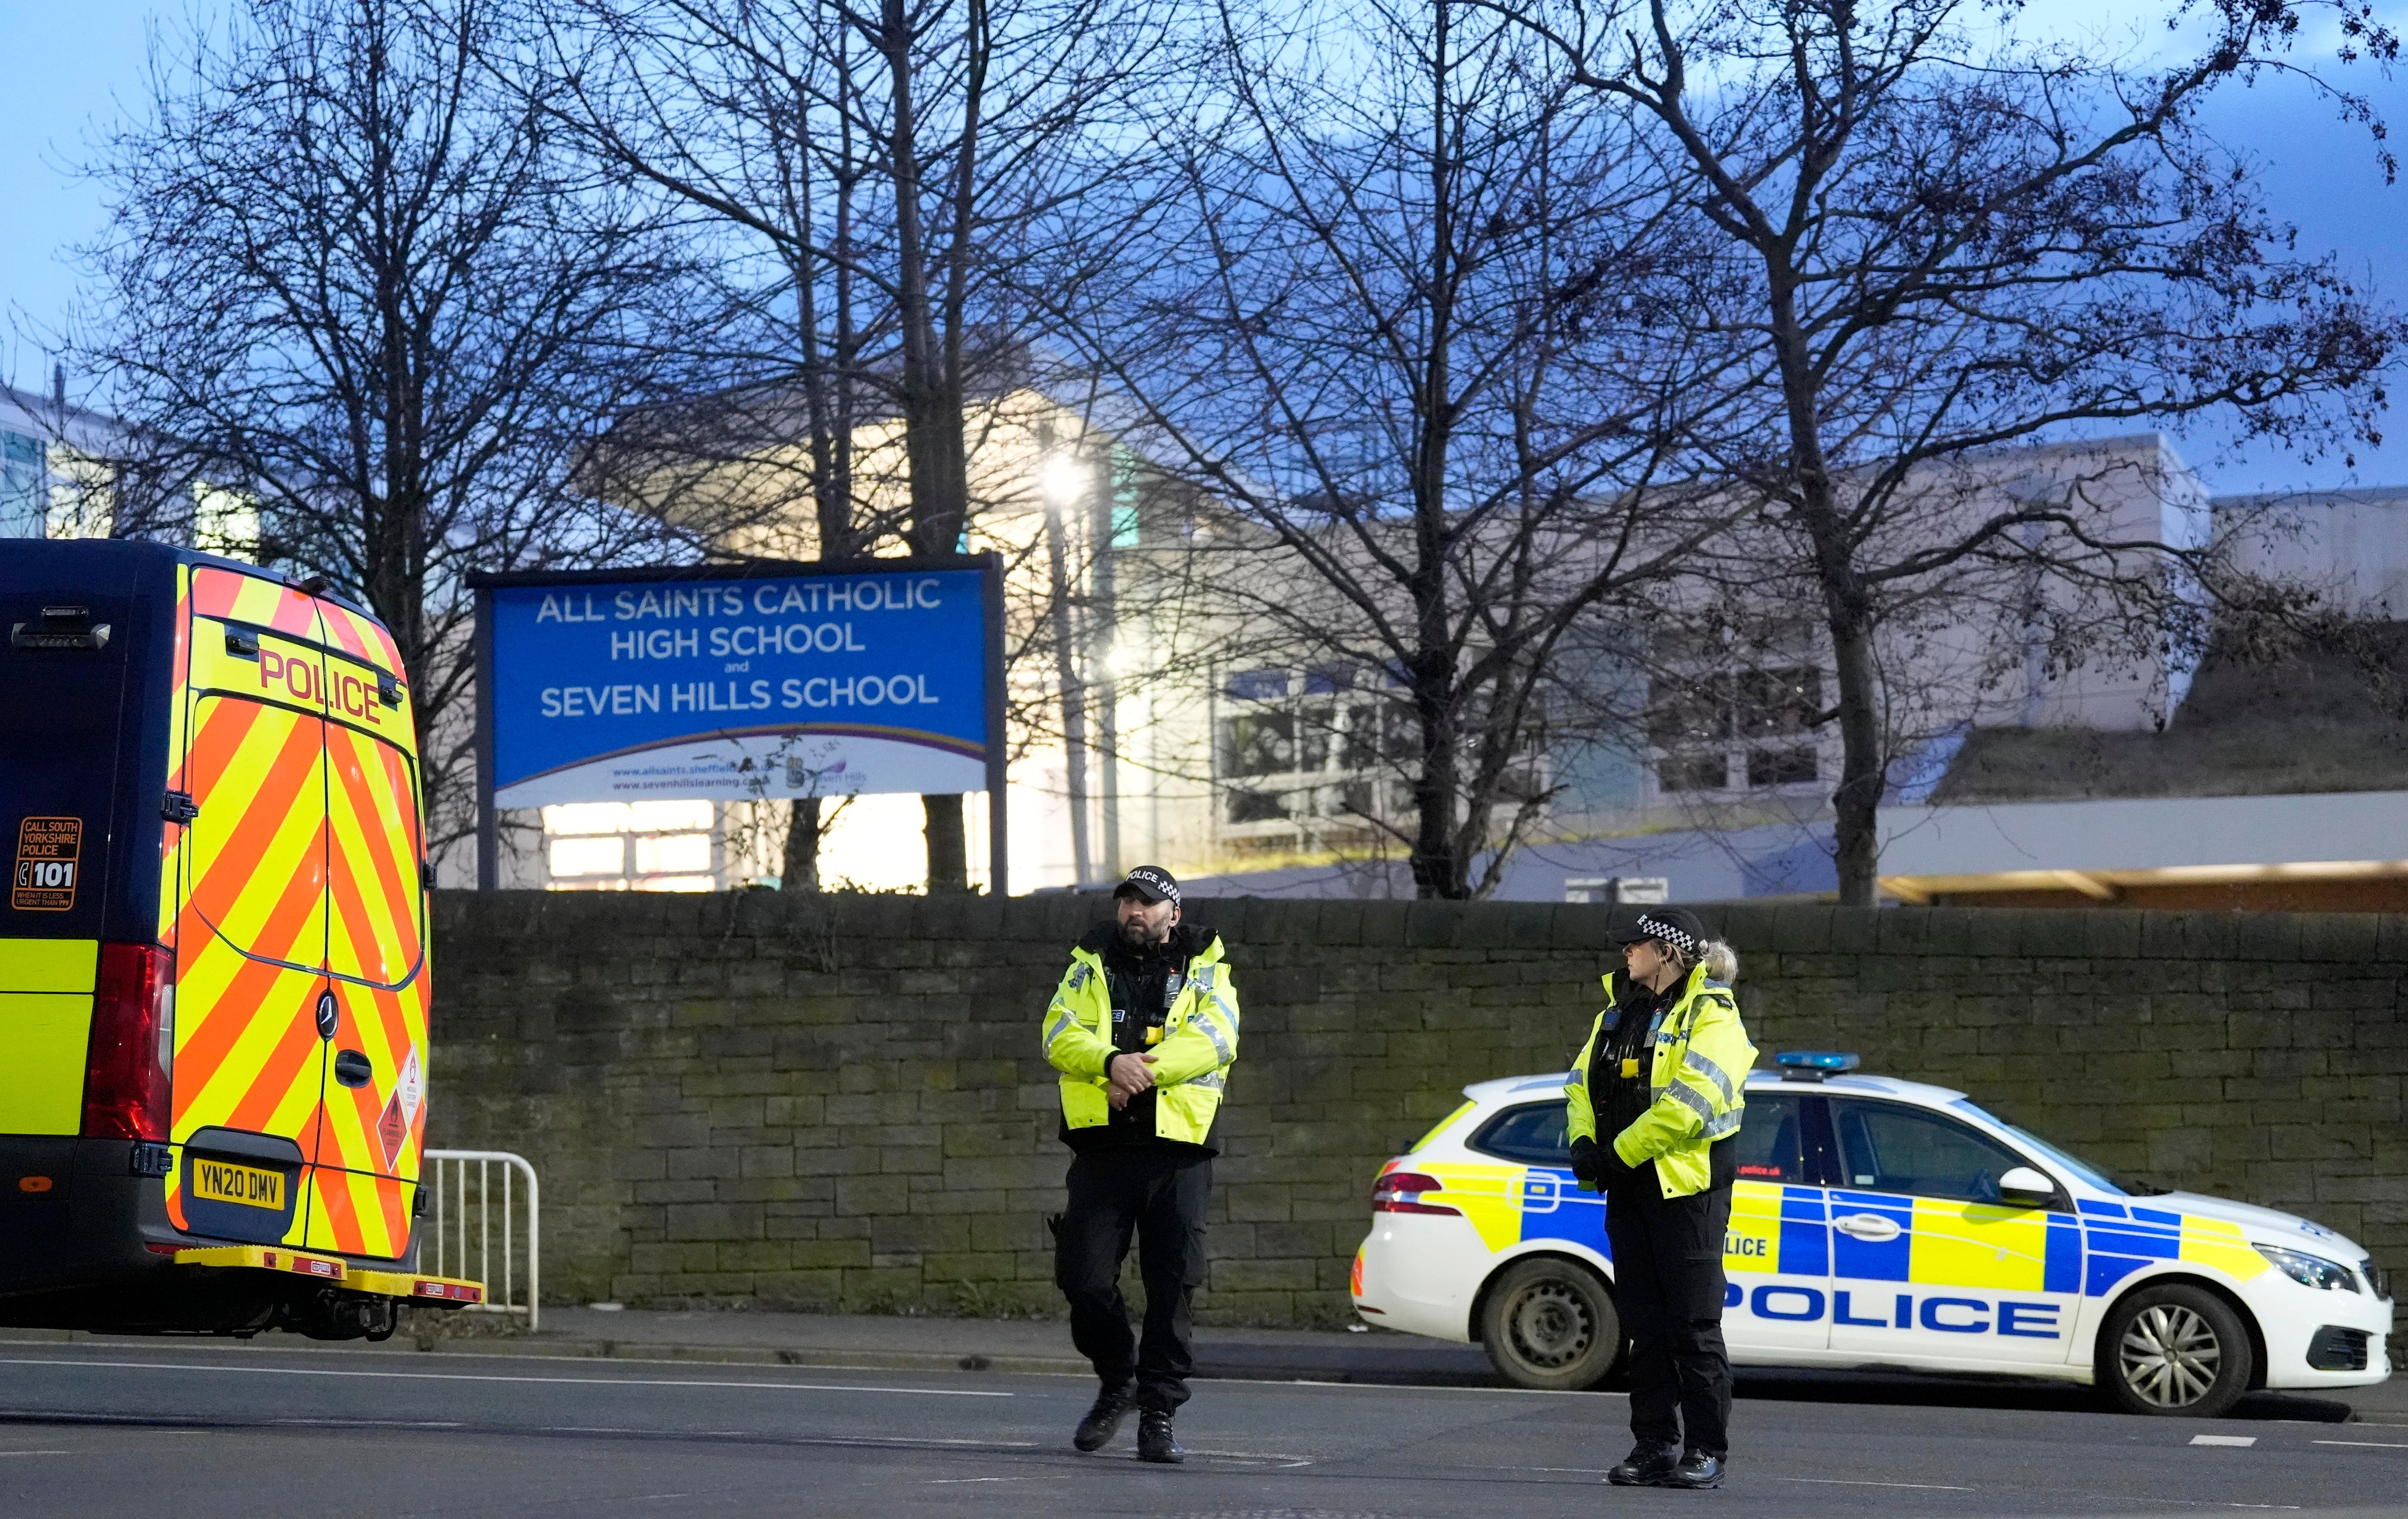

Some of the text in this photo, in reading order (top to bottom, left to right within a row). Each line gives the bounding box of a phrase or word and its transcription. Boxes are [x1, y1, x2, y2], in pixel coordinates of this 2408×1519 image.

[537, 580, 941, 622] ALL SAINTS CATHOLIC
[611, 622, 866, 661] HIGH SCHOOL
[724, 659, 750, 673] and
[259, 649, 380, 725] POLICE
[541, 674, 939, 717] SEVEN HILLS SCHOOL
[25, 822, 78, 832] CALL SOUTH
[24, 833, 77, 844] YORKSHIRE
[22, 845, 59, 855] POLICE
[34, 863, 74, 887] 101
[1126, 870, 1158, 883] POLICE
[202, 1164, 277, 1203] YN20 DMV
[1724, 1237, 1767, 1257] LICE
